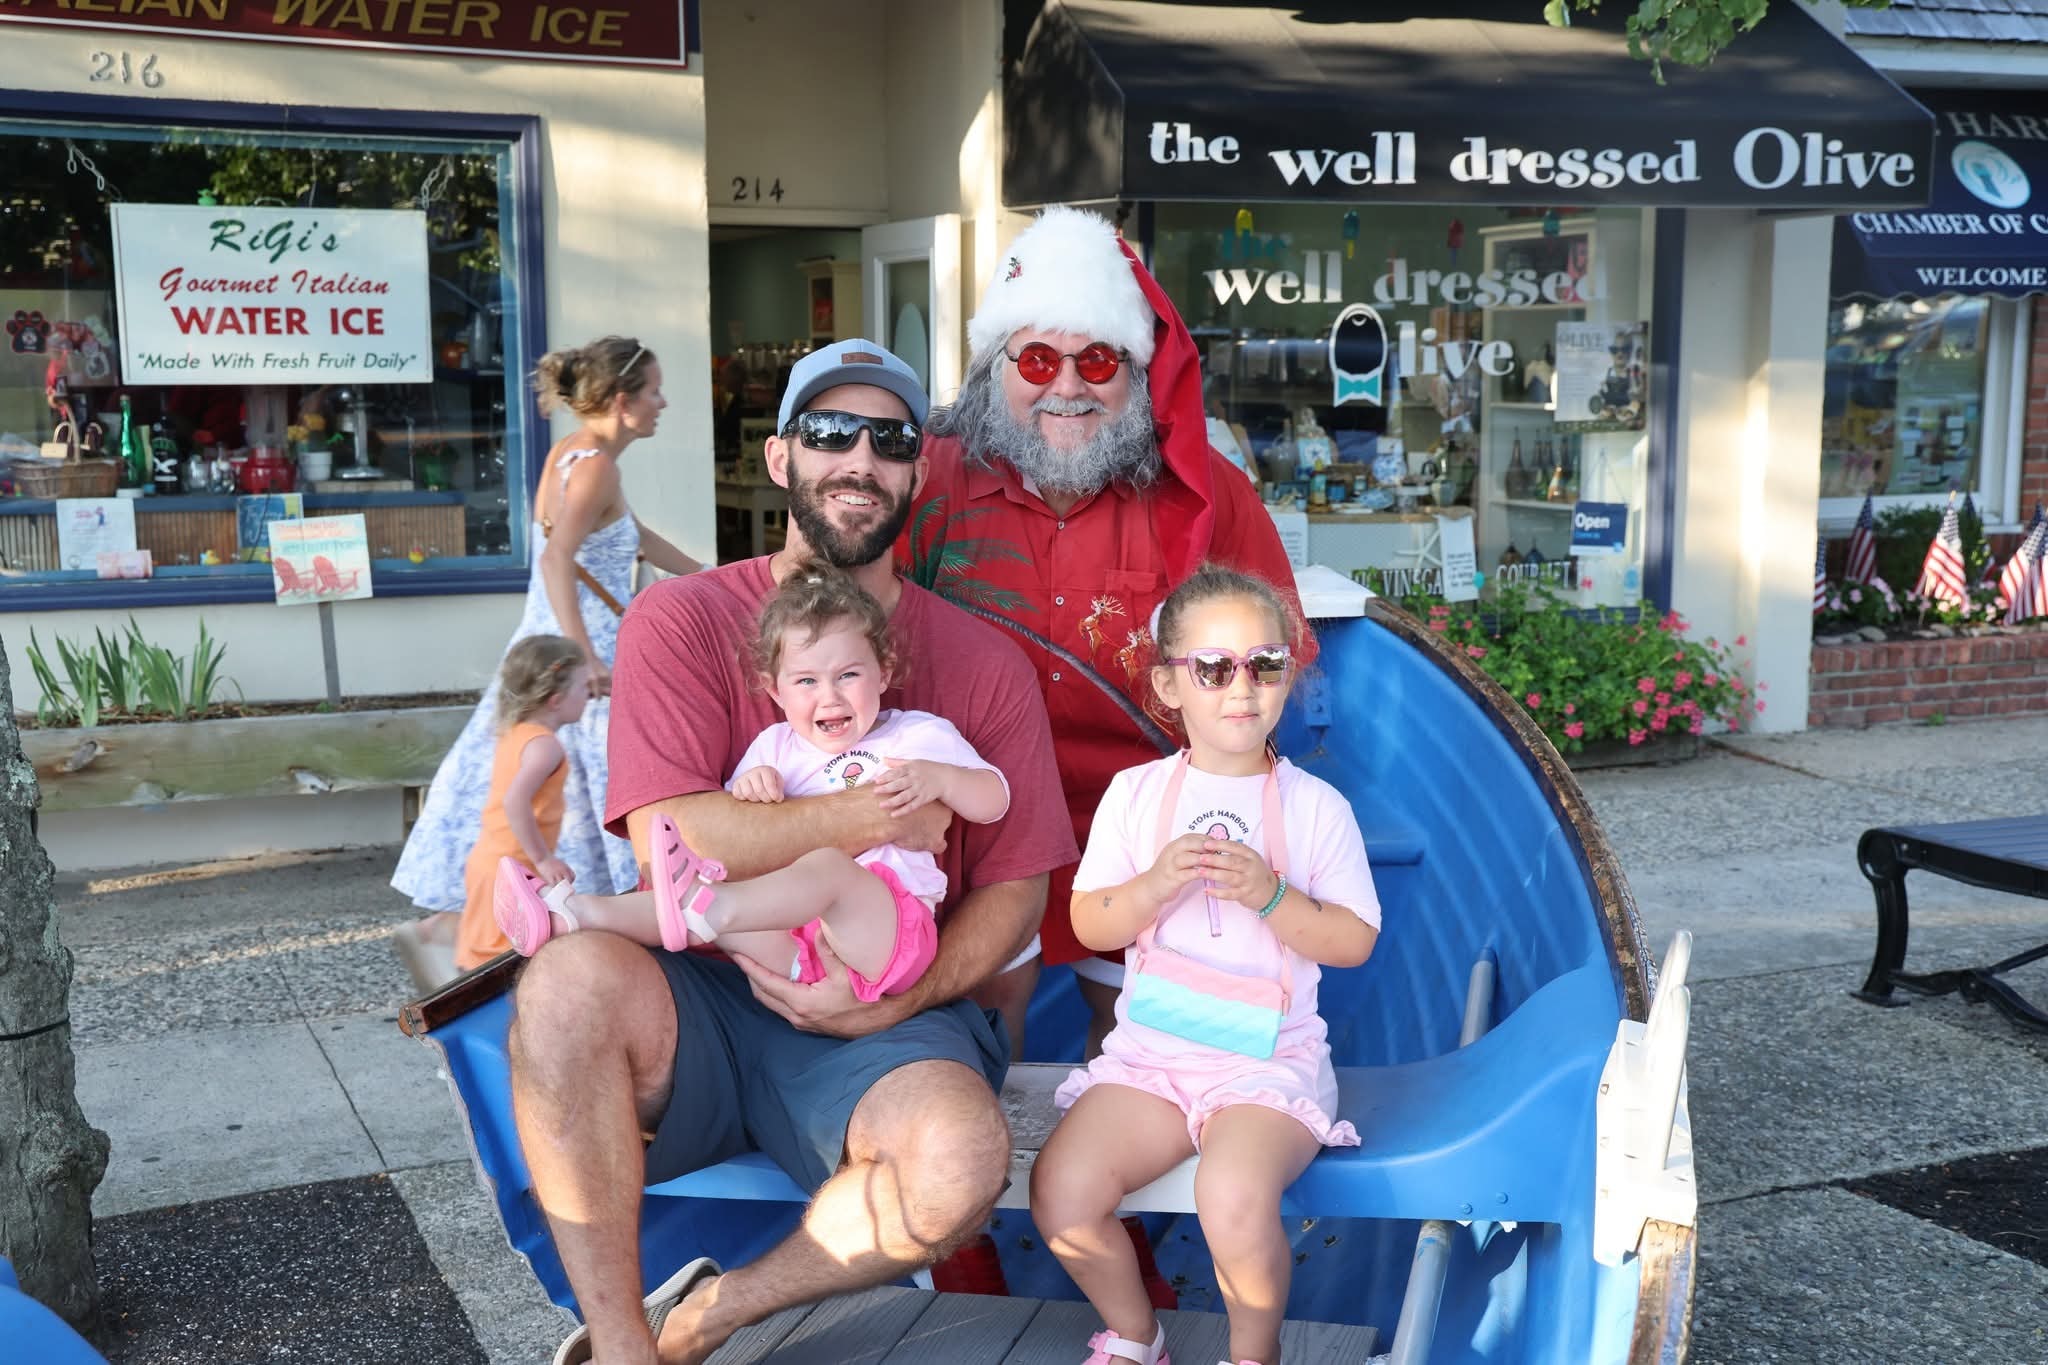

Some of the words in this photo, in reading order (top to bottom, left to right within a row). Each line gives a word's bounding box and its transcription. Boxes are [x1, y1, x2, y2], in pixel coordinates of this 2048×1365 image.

[271, 0, 502, 39] WATER
[529, 6, 631, 47] ICE
[88, 50, 165, 88] 216
[1946, 111, 2048, 141] HAR
[1148, 121, 1241, 164] the
[1267, 131, 1417, 186] well
[1449, 136, 1702, 189] dressed
[1733, 126, 1916, 190] Olive
[731, 175, 785, 203] 214
[1853, 212, 1989, 234] CHAMBER
[1988, 213, 2024, 234] OF
[209, 218, 340, 263] RiGi's
[159, 267, 280, 301] Gourmet
[291, 269, 390, 295] Italian
[1202, 251, 1344, 306] well
[1373, 258, 1608, 308] dressed
[1916, 267, 2047, 286] WELCOME
[170, 306, 311, 336] WATER
[330, 307, 386, 336] ICE
[211, 352, 255, 369] With
[262, 352, 310, 369] Fresh
[317, 352, 356, 369] Fruit
[1575, 511, 1610, 531] Open
[823, 751, 849, 775] STONE
[1188, 810, 1215, 831] STONE
[1217, 809, 1249, 834] HARBOR
